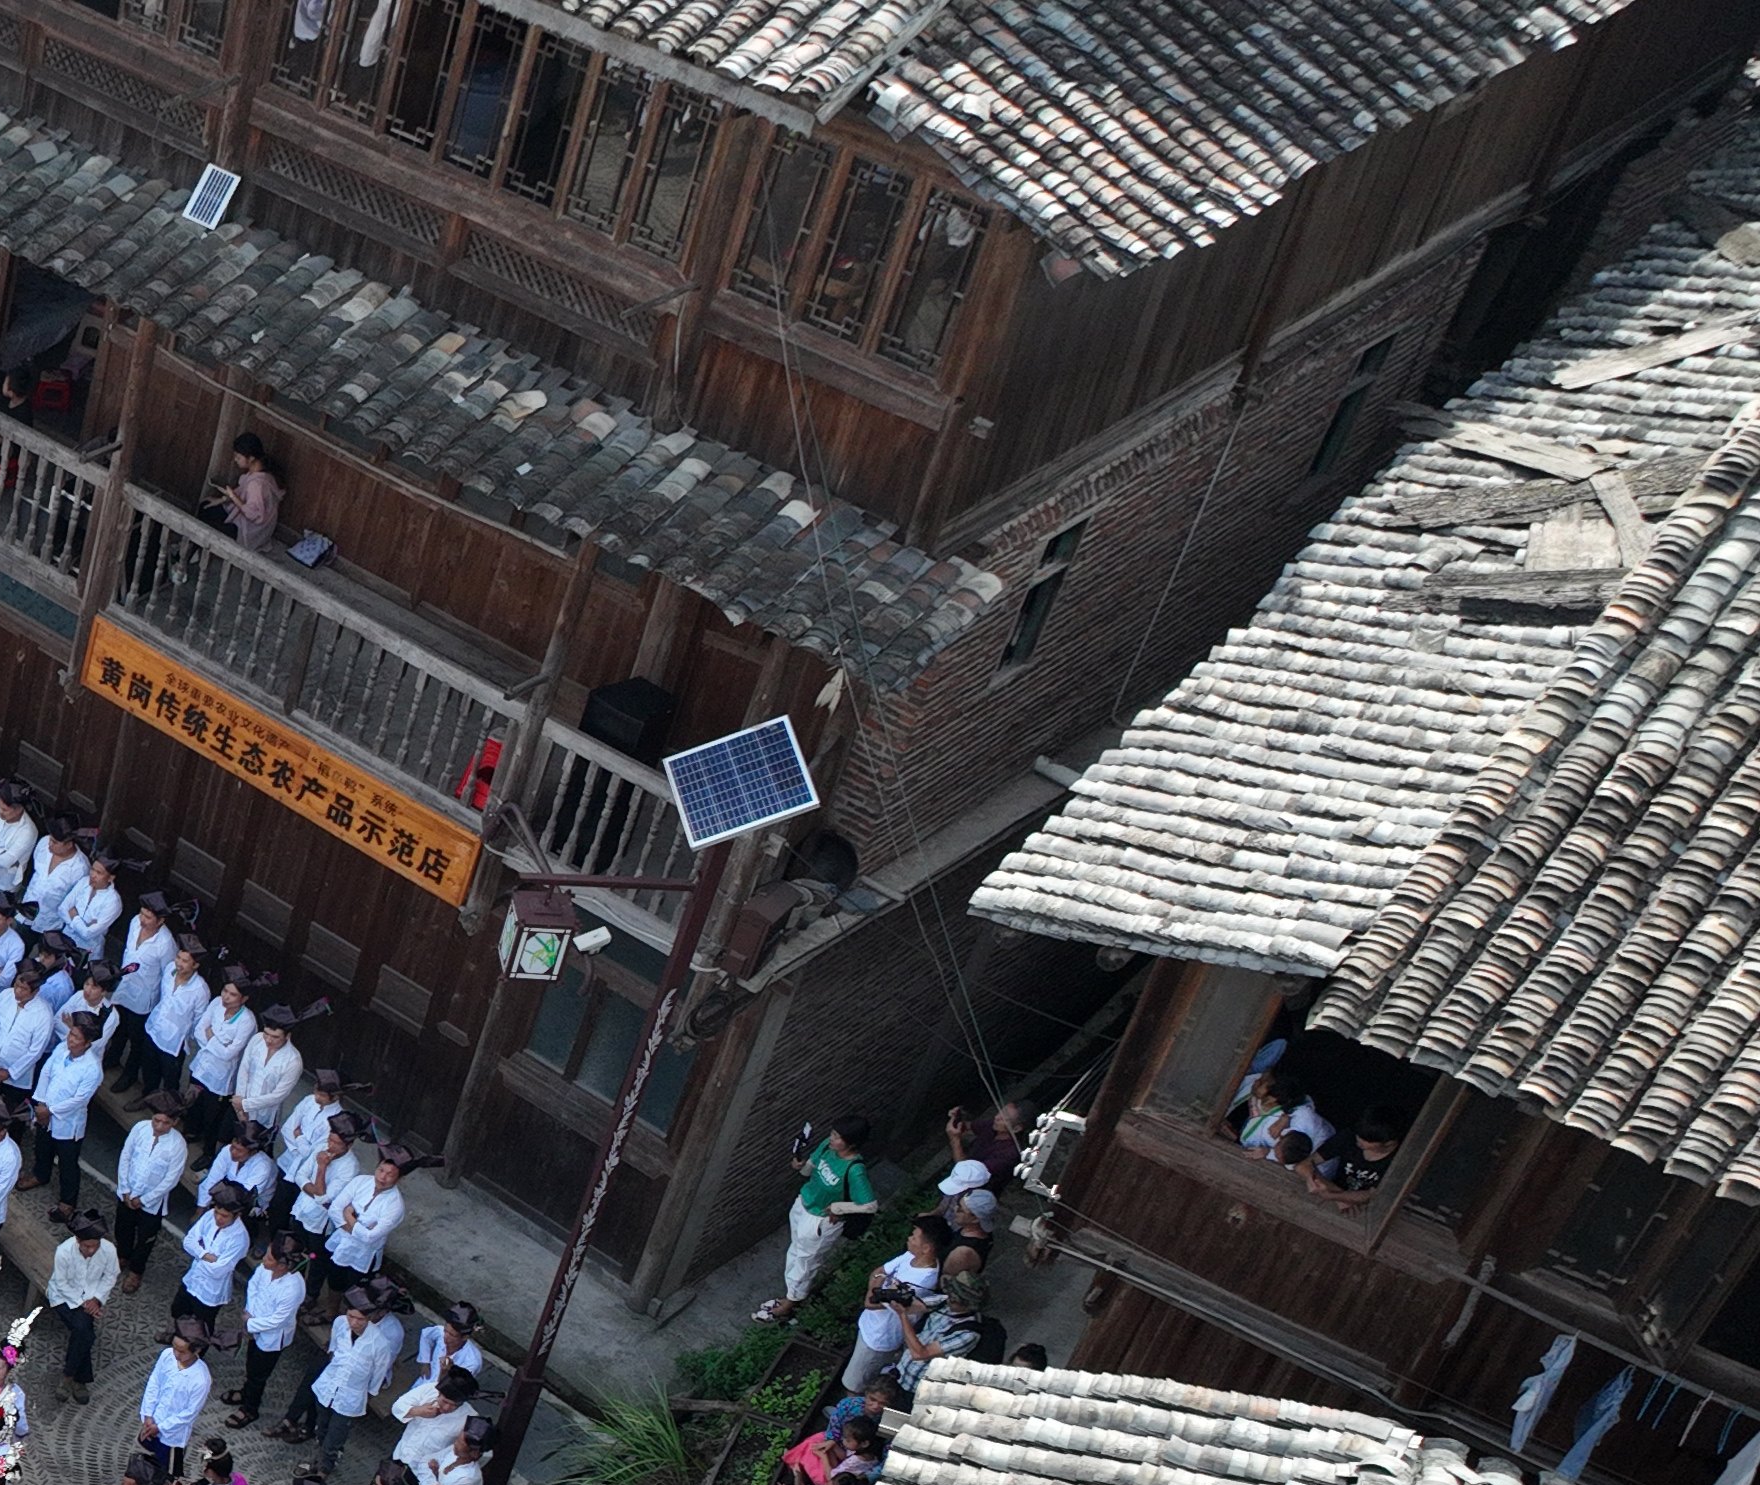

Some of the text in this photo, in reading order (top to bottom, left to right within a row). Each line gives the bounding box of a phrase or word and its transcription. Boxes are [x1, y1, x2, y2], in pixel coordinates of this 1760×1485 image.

[98, 656, 452, 885] 黄岗传统生态农产品示范店
[370, 792, 398, 817] 系统
